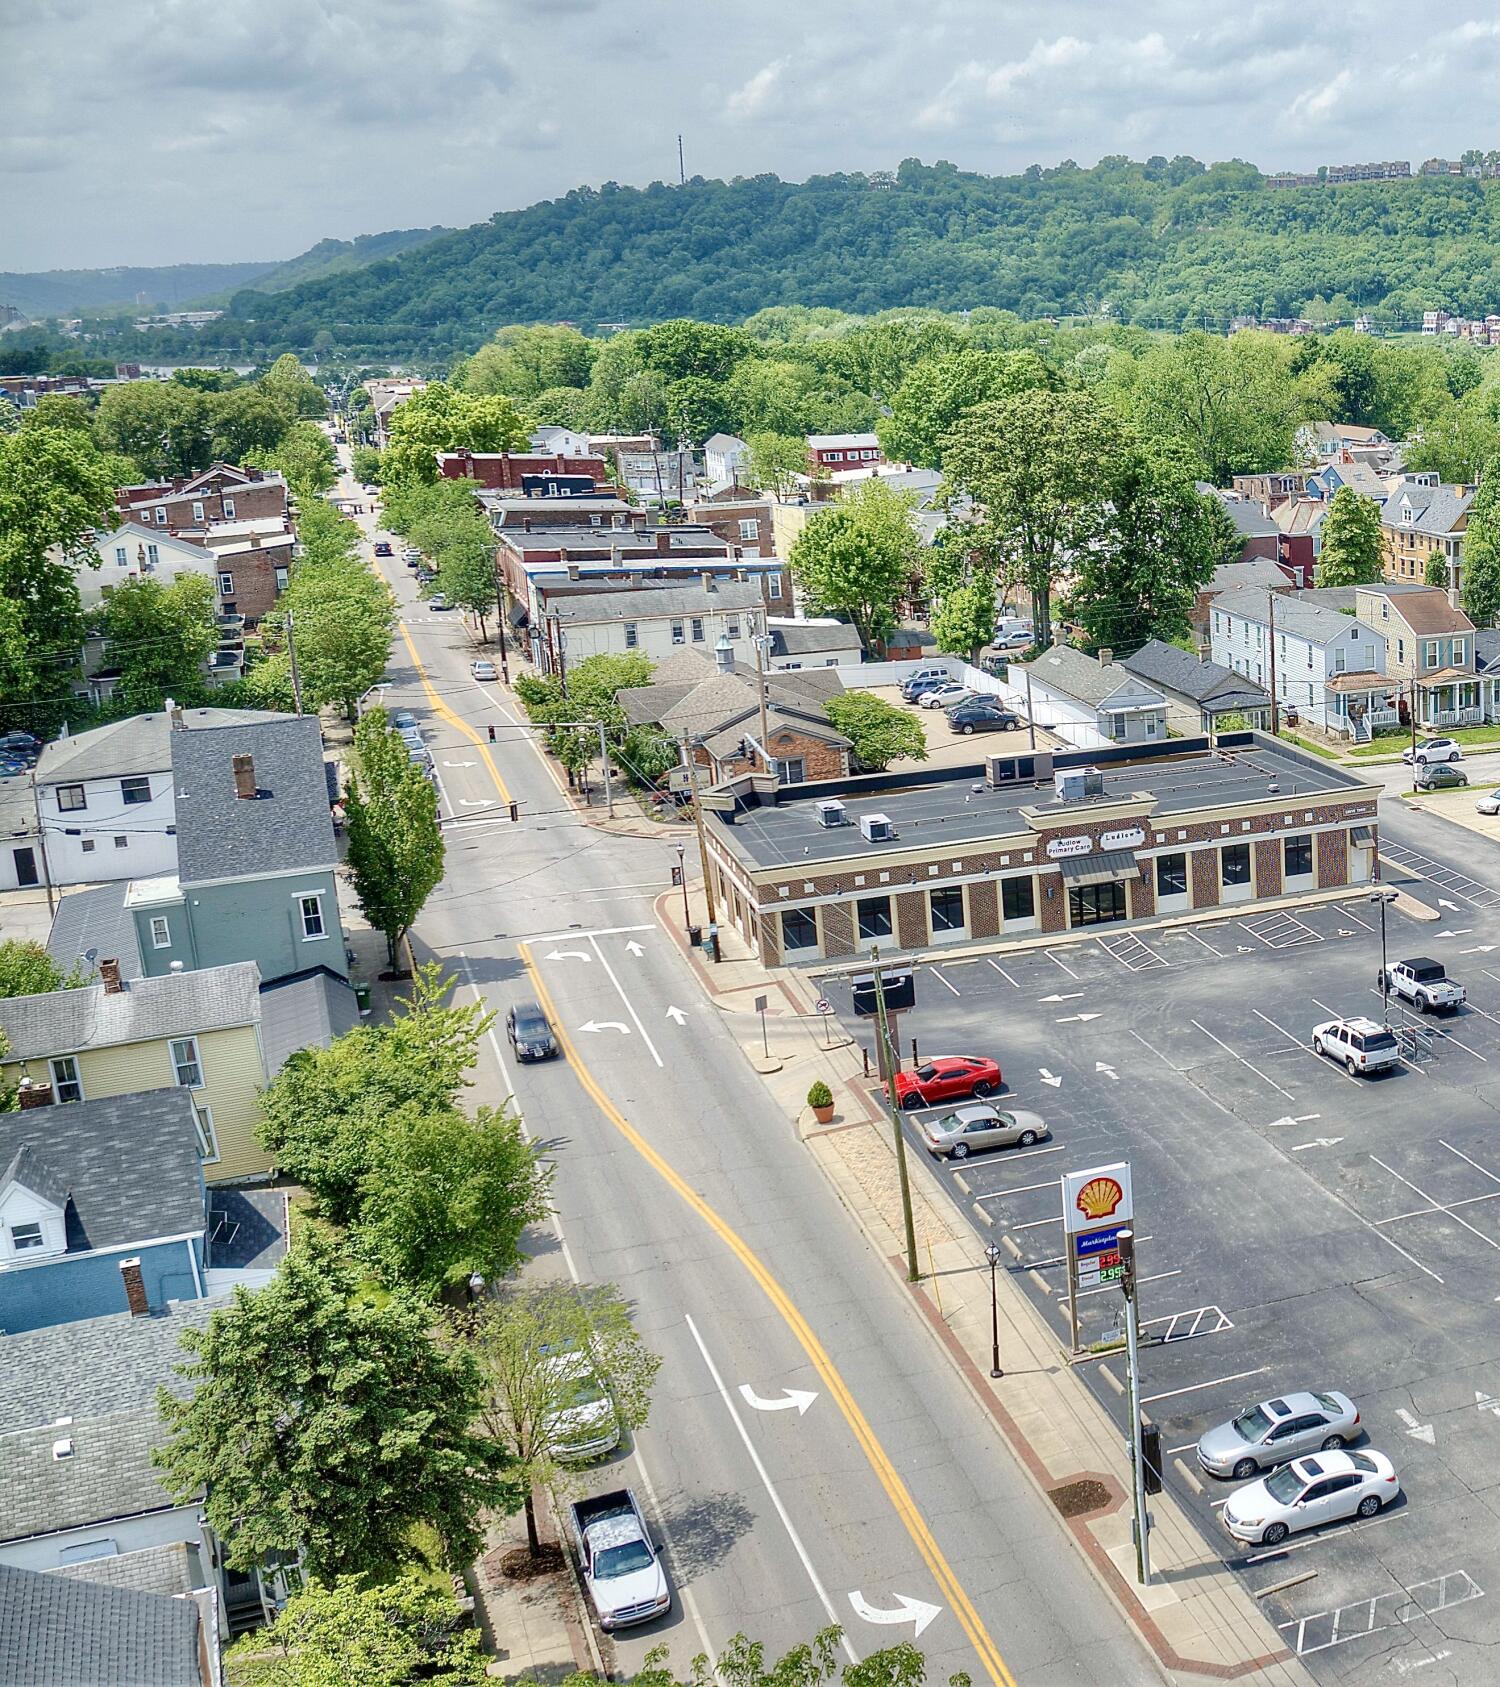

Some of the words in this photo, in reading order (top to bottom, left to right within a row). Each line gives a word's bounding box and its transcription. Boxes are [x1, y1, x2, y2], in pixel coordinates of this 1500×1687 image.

[1105, 831, 1134, 841] Ludlow
[1048, 846, 1074, 854] Primary
[1081, 1235, 1117, 1248] Marketplac
